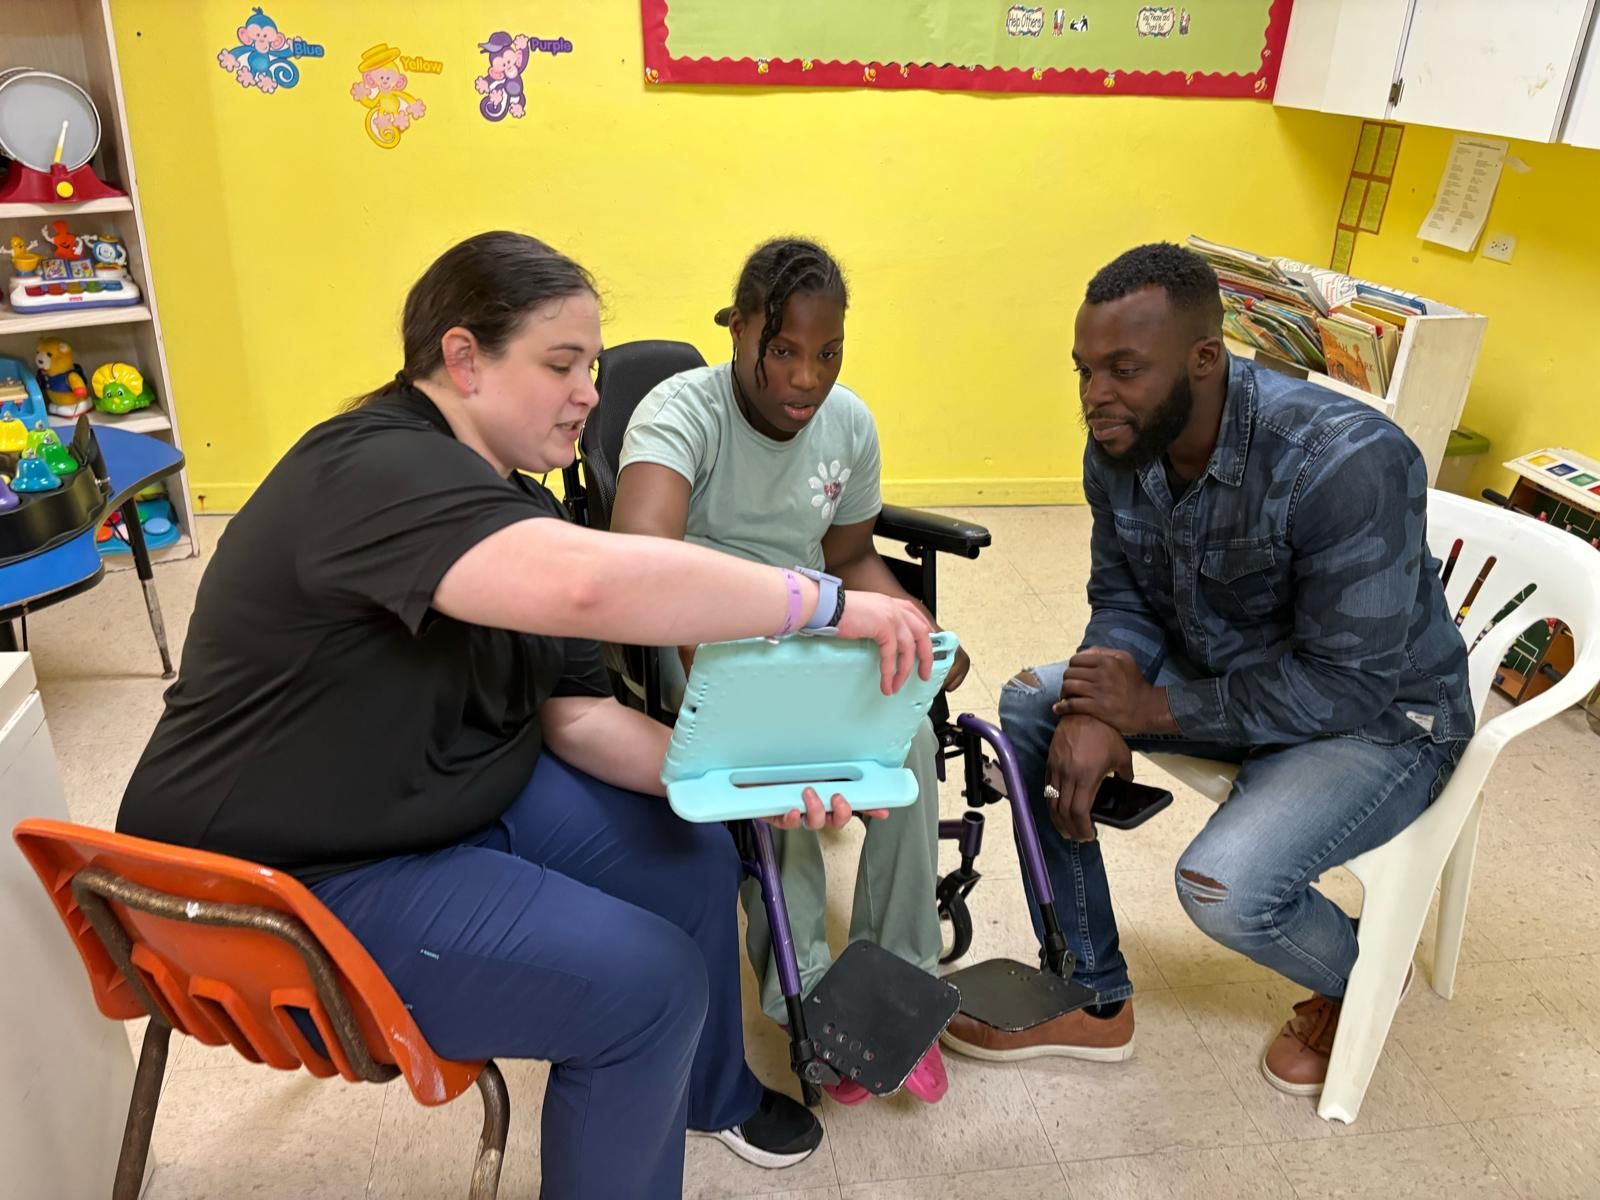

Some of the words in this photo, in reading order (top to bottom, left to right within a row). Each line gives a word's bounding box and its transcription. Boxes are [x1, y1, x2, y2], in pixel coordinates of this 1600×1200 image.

[293, 41, 324, 58] Blue
[530, 37, 572, 55] Purple
[400, 56, 442, 74] Yellow
